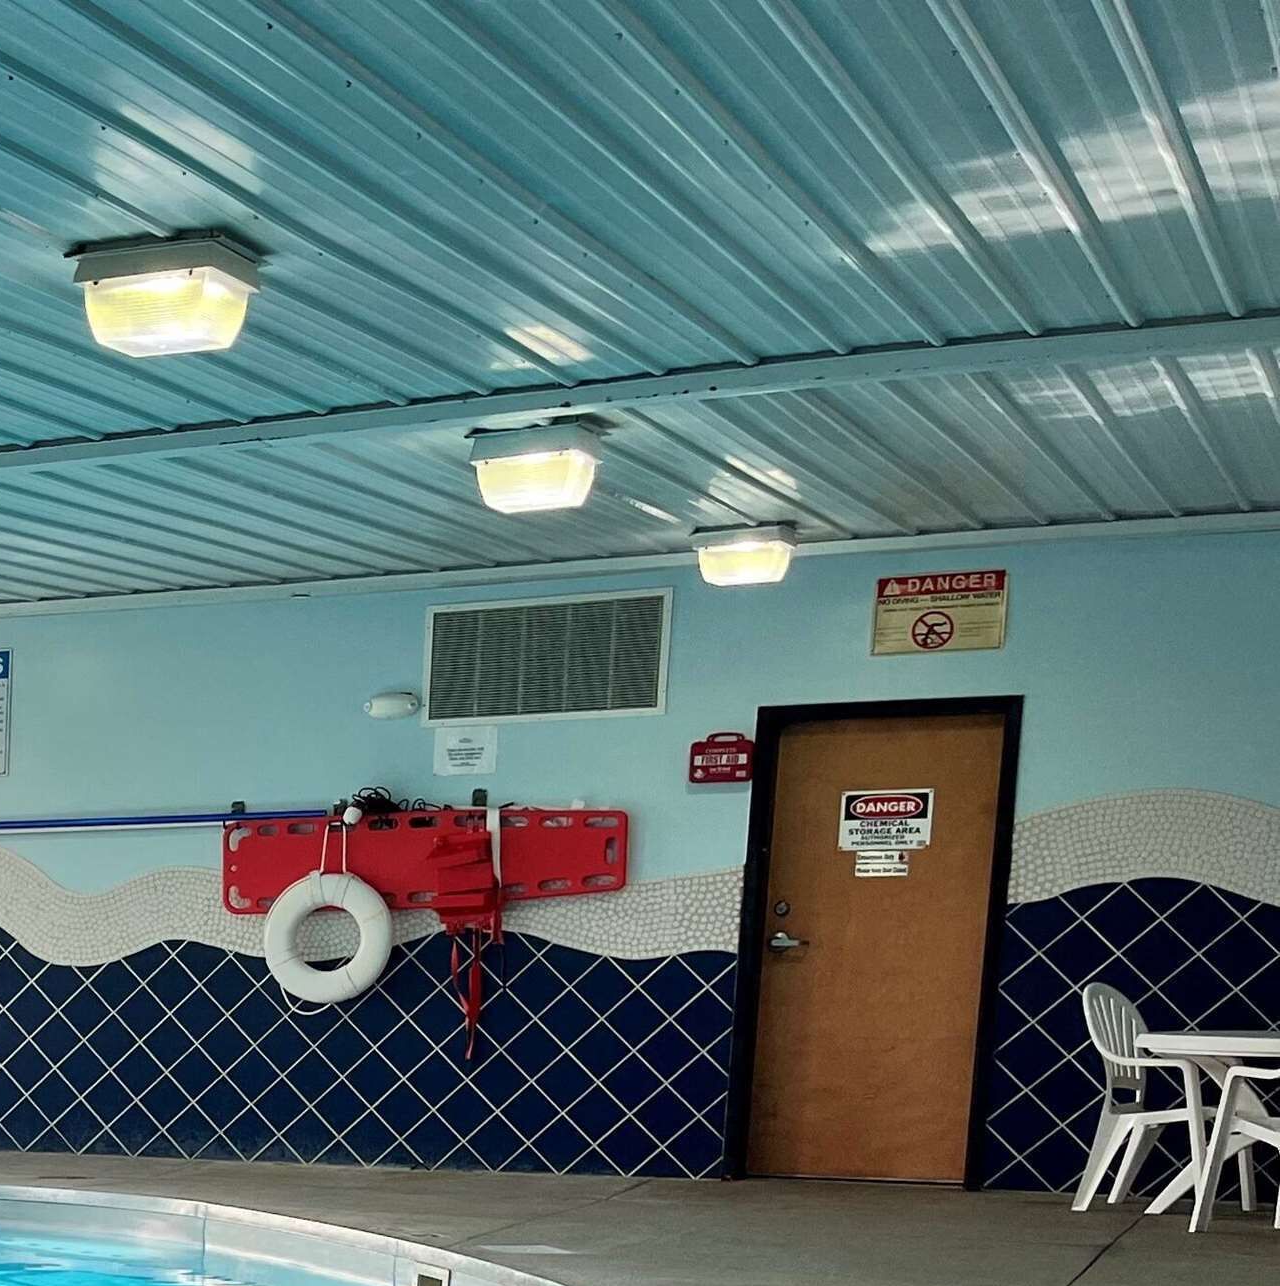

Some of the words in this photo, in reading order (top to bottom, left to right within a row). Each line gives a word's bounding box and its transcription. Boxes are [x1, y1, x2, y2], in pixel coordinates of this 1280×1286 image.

[907, 573, 997, 593] DANGER
[856, 801, 916, 813] DANGER
[859, 820, 910, 828] CHEMICAL
[848, 828, 892, 836] STORAGE
